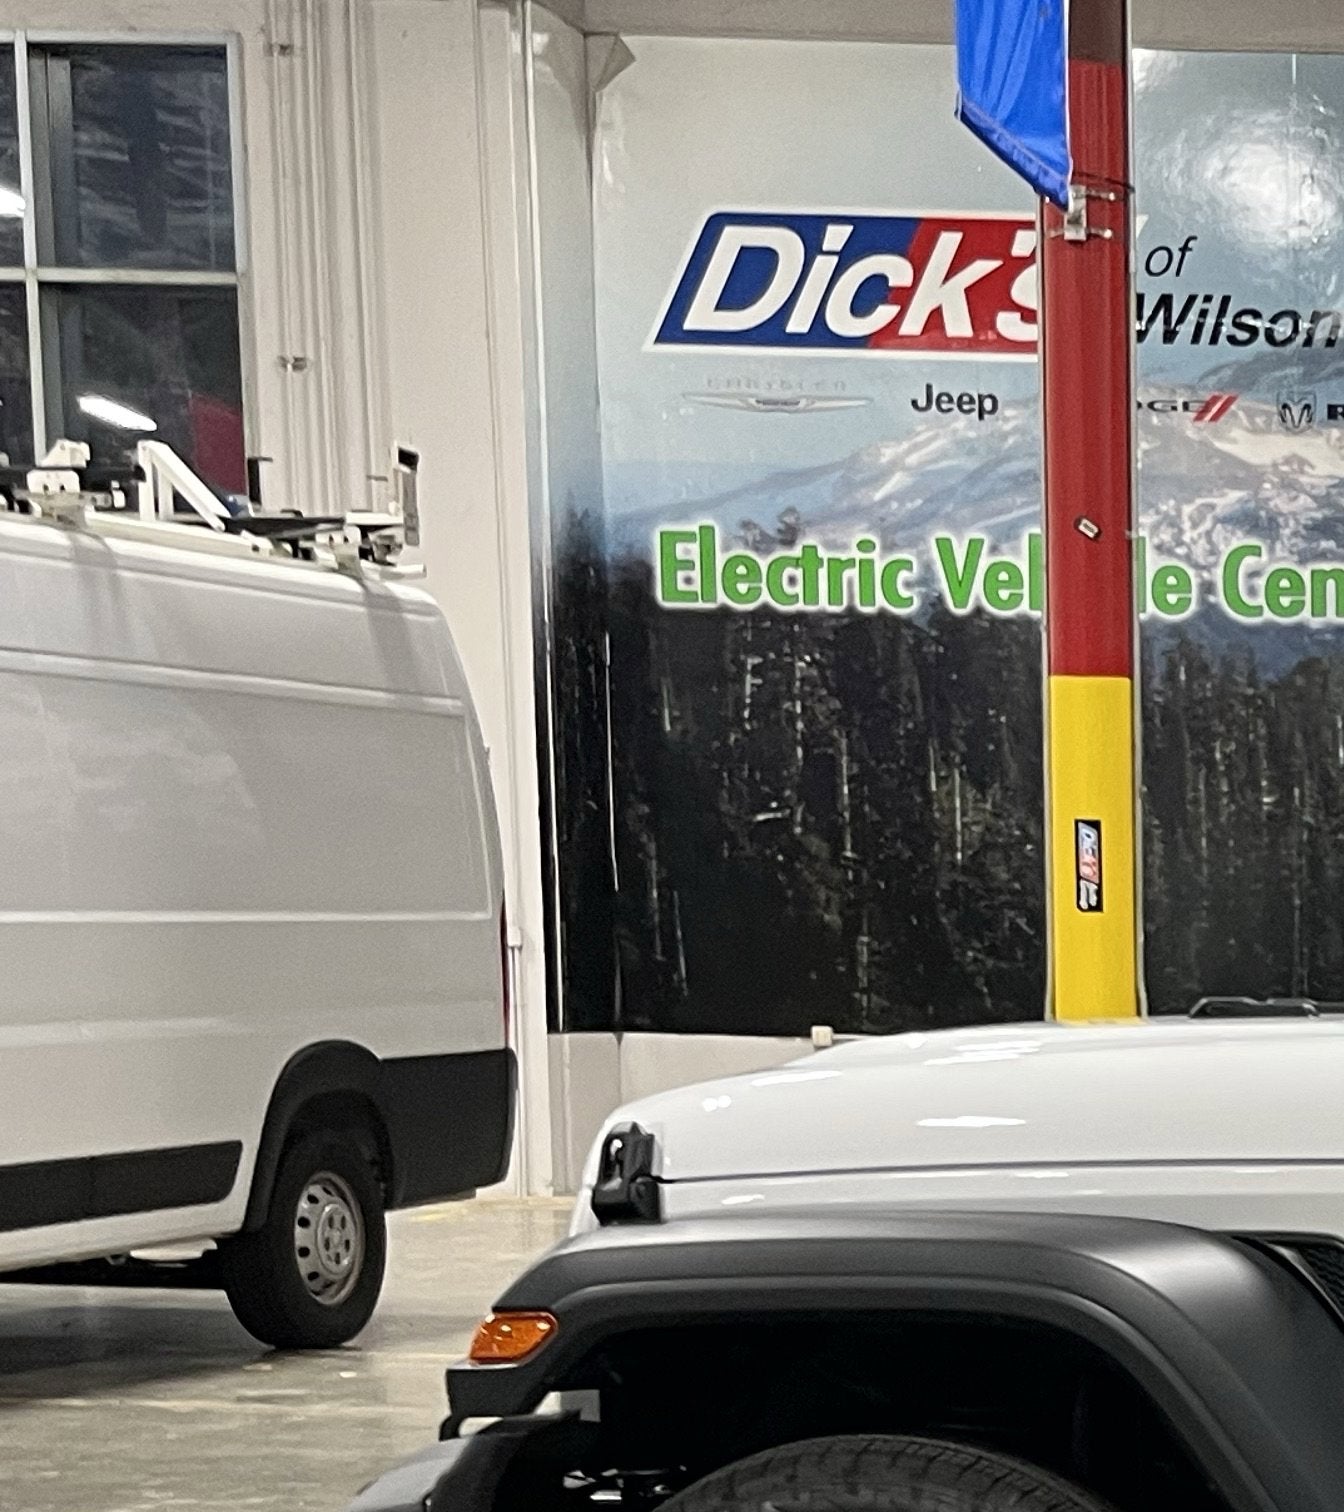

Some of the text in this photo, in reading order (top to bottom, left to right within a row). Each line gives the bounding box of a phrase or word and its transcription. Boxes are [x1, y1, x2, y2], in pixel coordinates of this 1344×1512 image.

[1144, 235, 1198, 278] of
[911, 382, 999, 421] Jeep
[659, 524, 914, 610] Electric
[935, 532, 1193, 617] Vele
